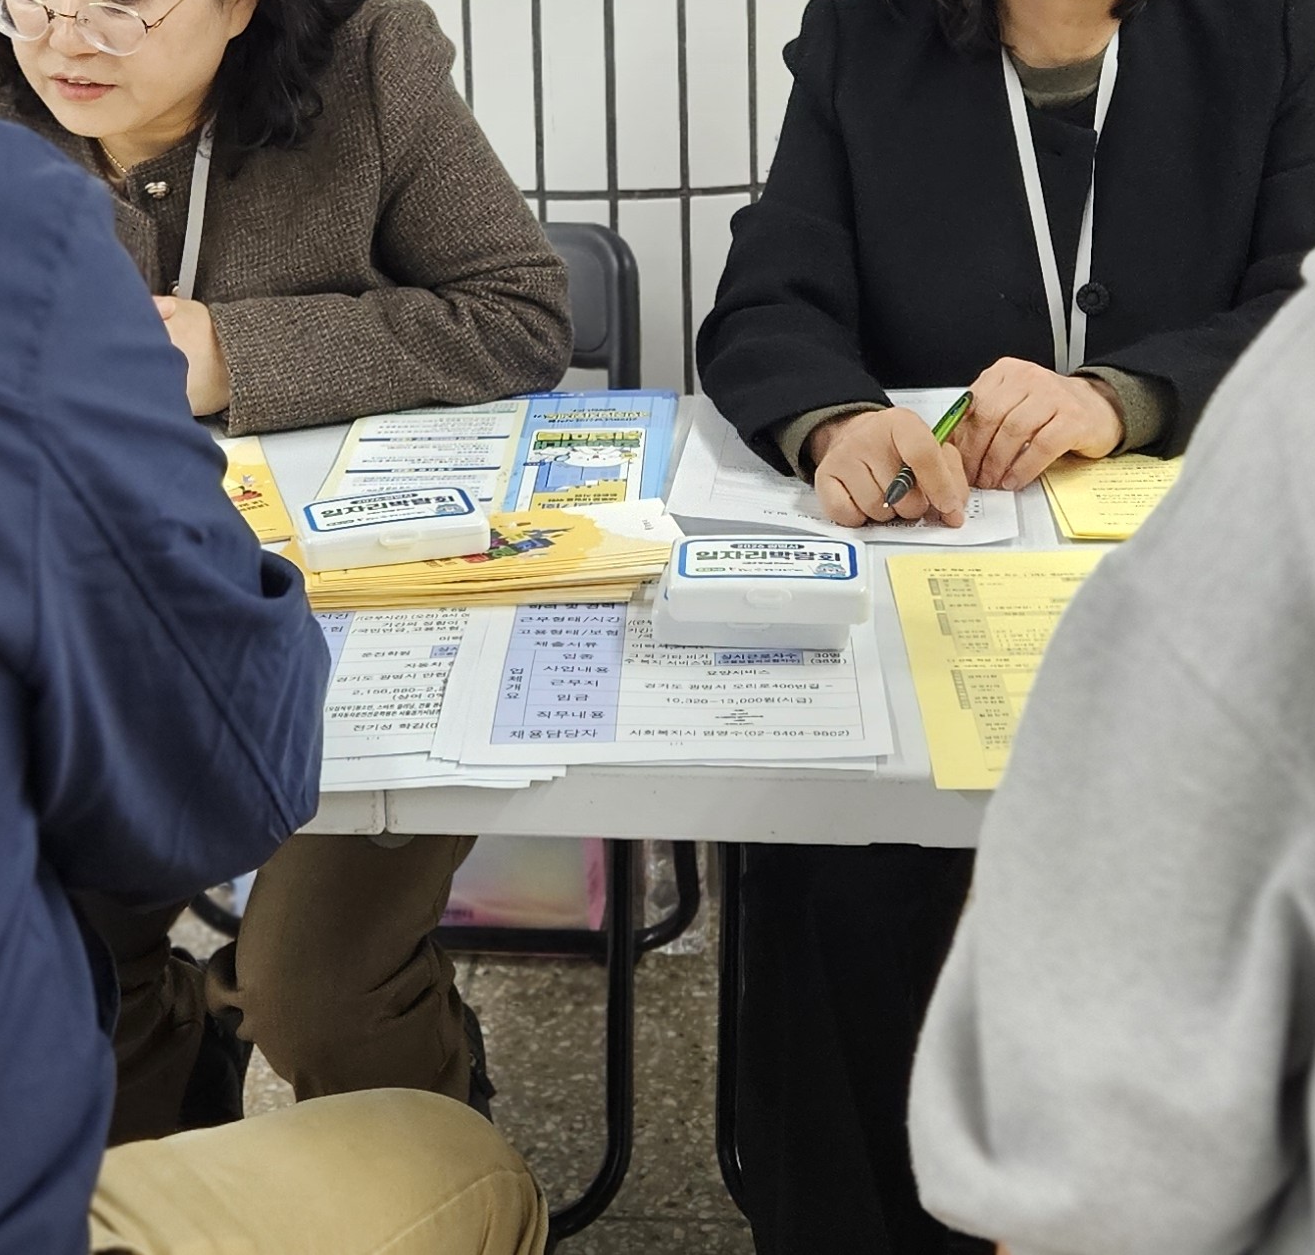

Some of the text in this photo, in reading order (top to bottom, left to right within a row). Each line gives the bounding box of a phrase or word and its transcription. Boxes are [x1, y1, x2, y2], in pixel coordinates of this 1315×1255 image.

[320, 495, 456, 519] 일자리박람회
[695, 550, 841, 562] 일자리박람회
[543, 665, 610, 674] 사업내용
[549, 679, 599, 687] 근무지
[536, 710, 605, 720] 직무내용
[509, 728, 598, 740] 채용담당자
